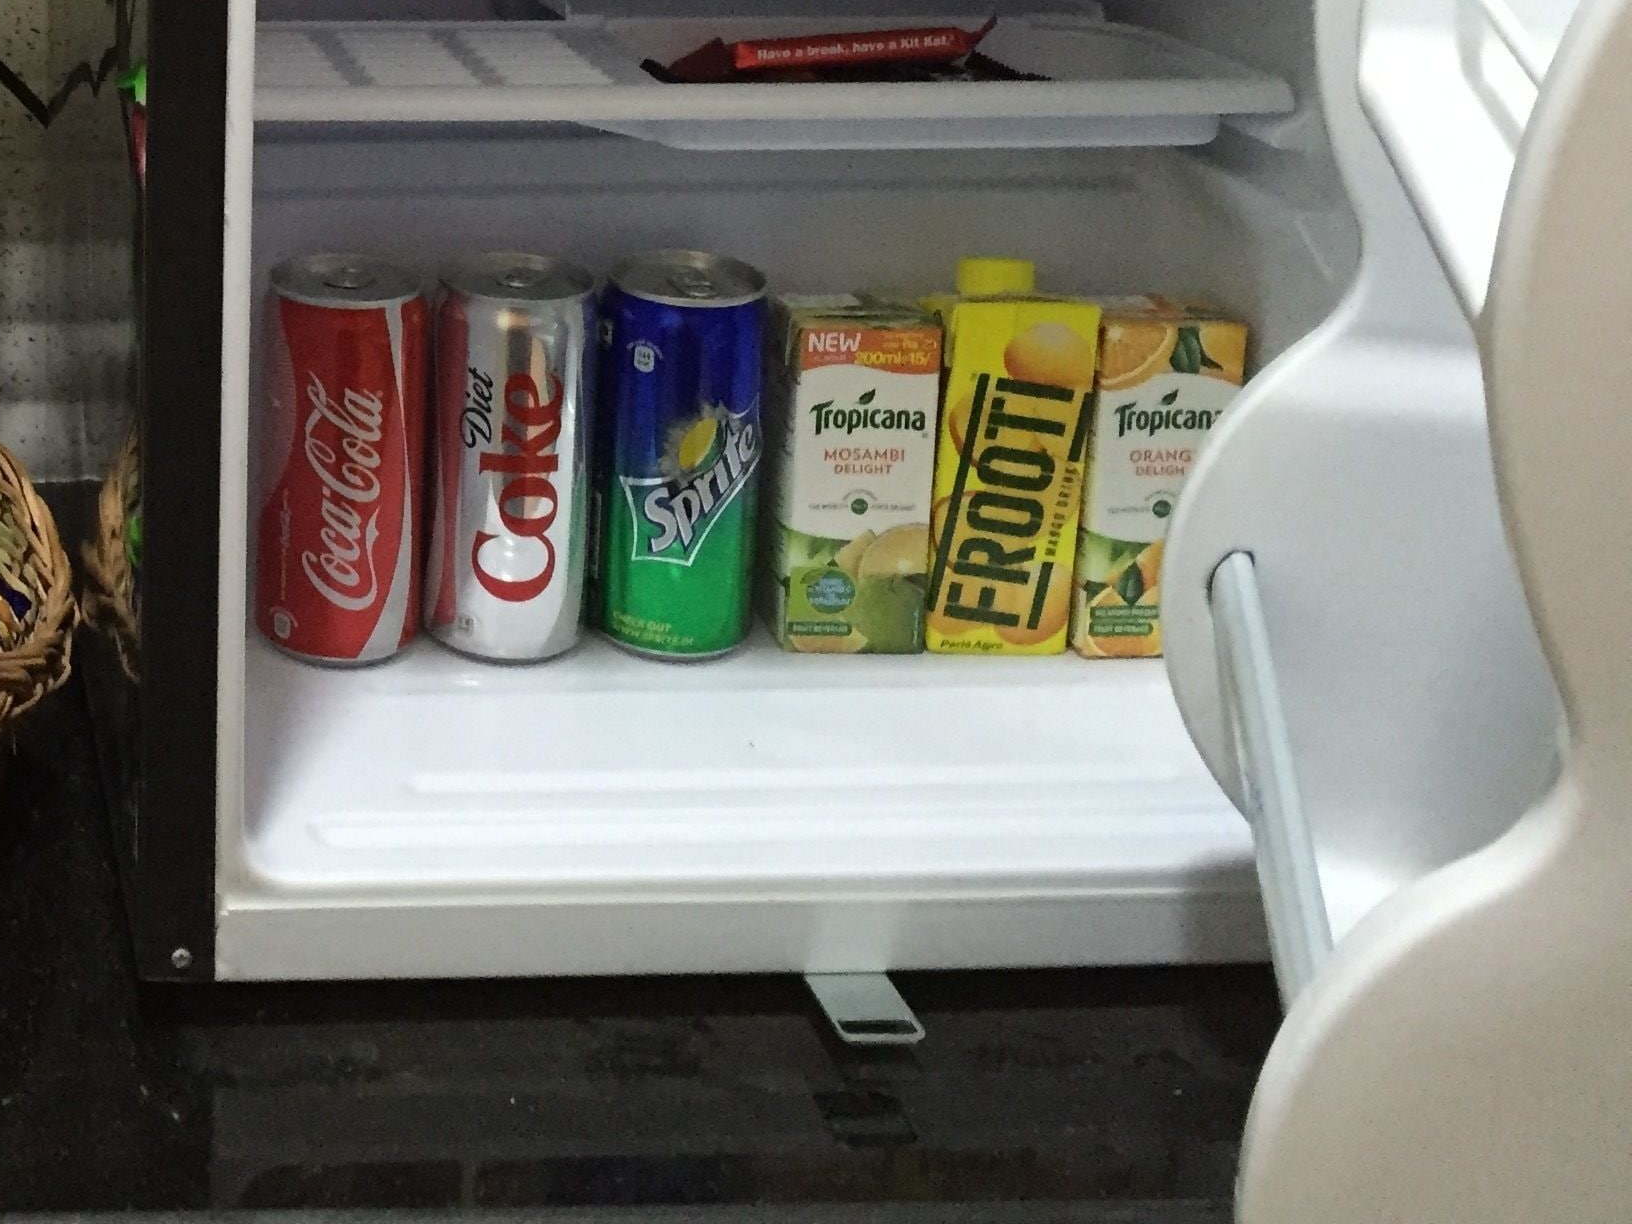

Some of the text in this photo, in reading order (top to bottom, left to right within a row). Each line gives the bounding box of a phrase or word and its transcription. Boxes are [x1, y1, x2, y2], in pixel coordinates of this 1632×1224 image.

[756, 48, 792, 61] Have
[794, 47, 804, 58] a
[852, 41, 885, 53] have
[888, 41, 898, 51] a
[900, 37, 920, 50] Kit
[808, 332, 863, 353] NEW
[459, 367, 494, 449] Diet
[809, 399, 926, 436] Tropicana
[1114, 401, 1223, 437] Tropican
[824, 448, 906, 462] MOSAMBI
[834, 464, 893, 475] DELIGHT
[1129, 450, 1193, 463] ORANG
[644, 418, 757, 554] Sprite
[1135, 466, 1185, 476] DELIGH
[302, 370, 384, 611] Coca-Cola
[471, 372, 564, 602] Coke
[943, 377, 1076, 627] FROOTI
[972, 640, 1004, 651] Agro
